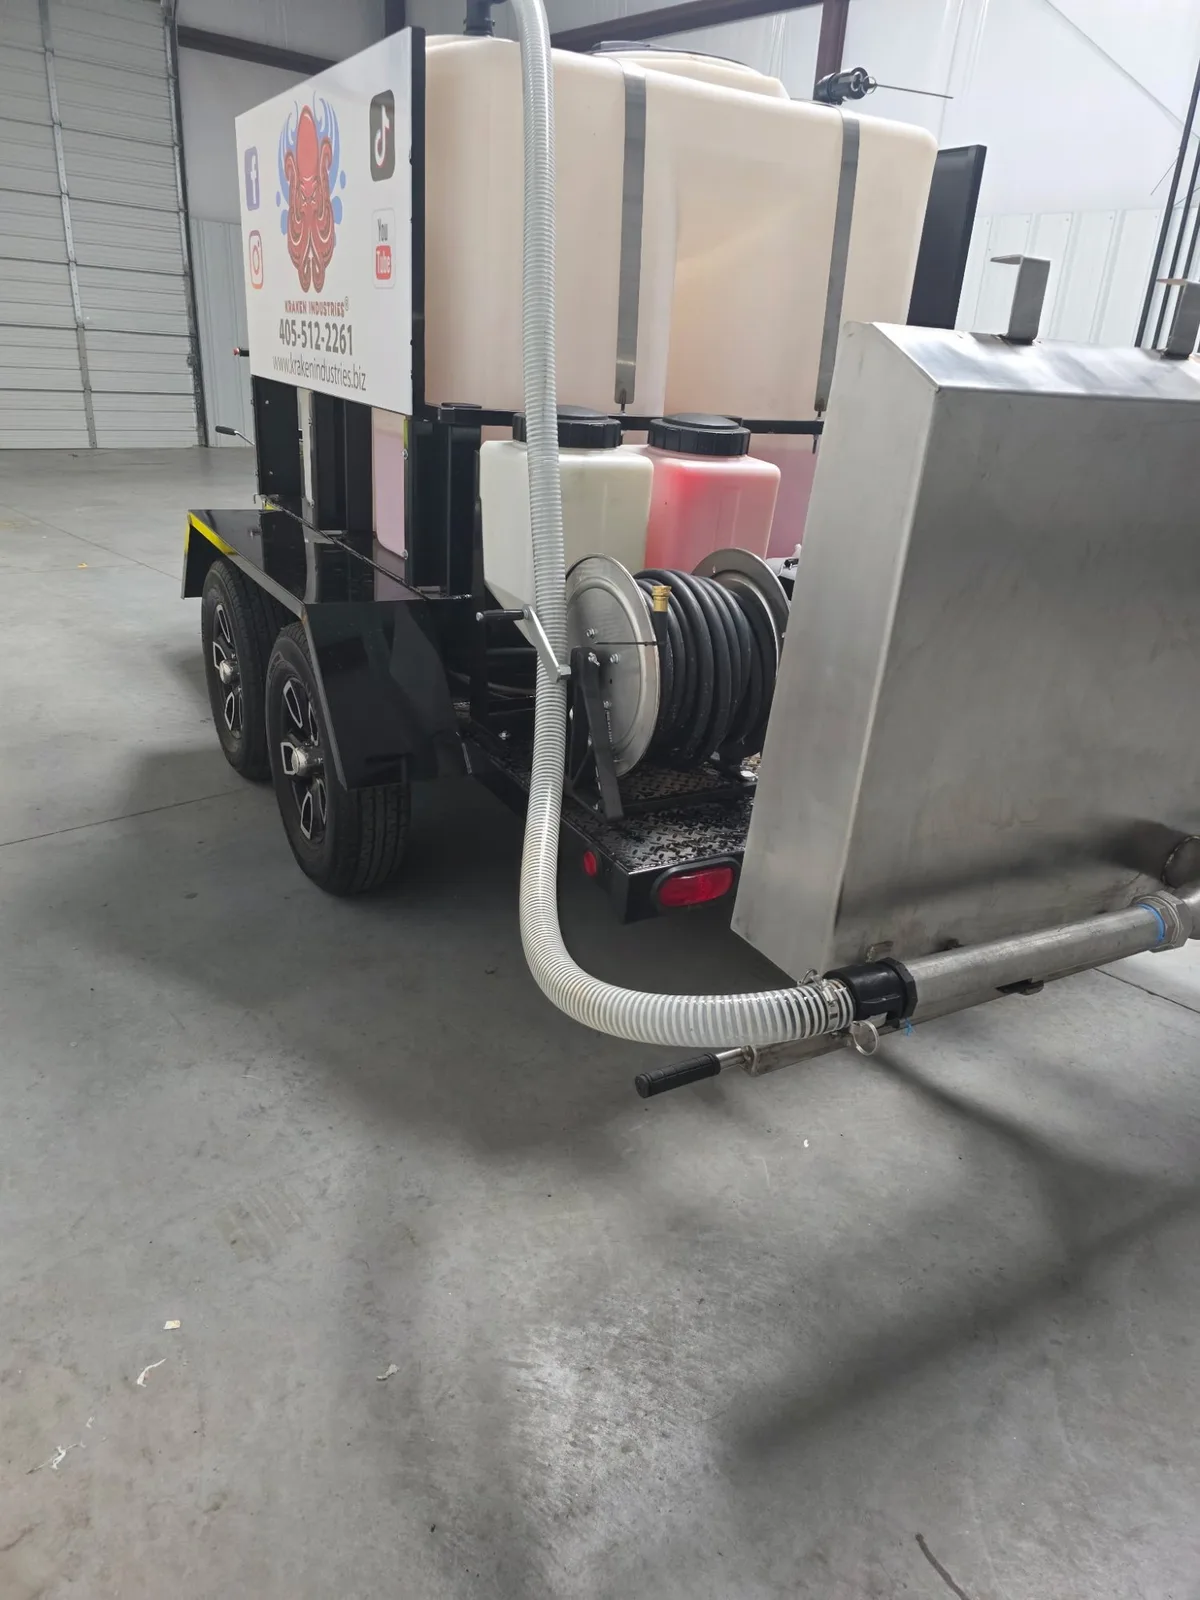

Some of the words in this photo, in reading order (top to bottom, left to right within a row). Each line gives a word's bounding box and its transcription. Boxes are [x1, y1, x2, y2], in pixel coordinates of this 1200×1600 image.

[377, 218, 388, 242] You
[376, 250, 391, 274] Tube
[284, 300, 307, 314] KRAKEN
[279, 318, 353, 356] 405-512-2261
[272, 352, 366, 391] www.krakenindustries.biz
